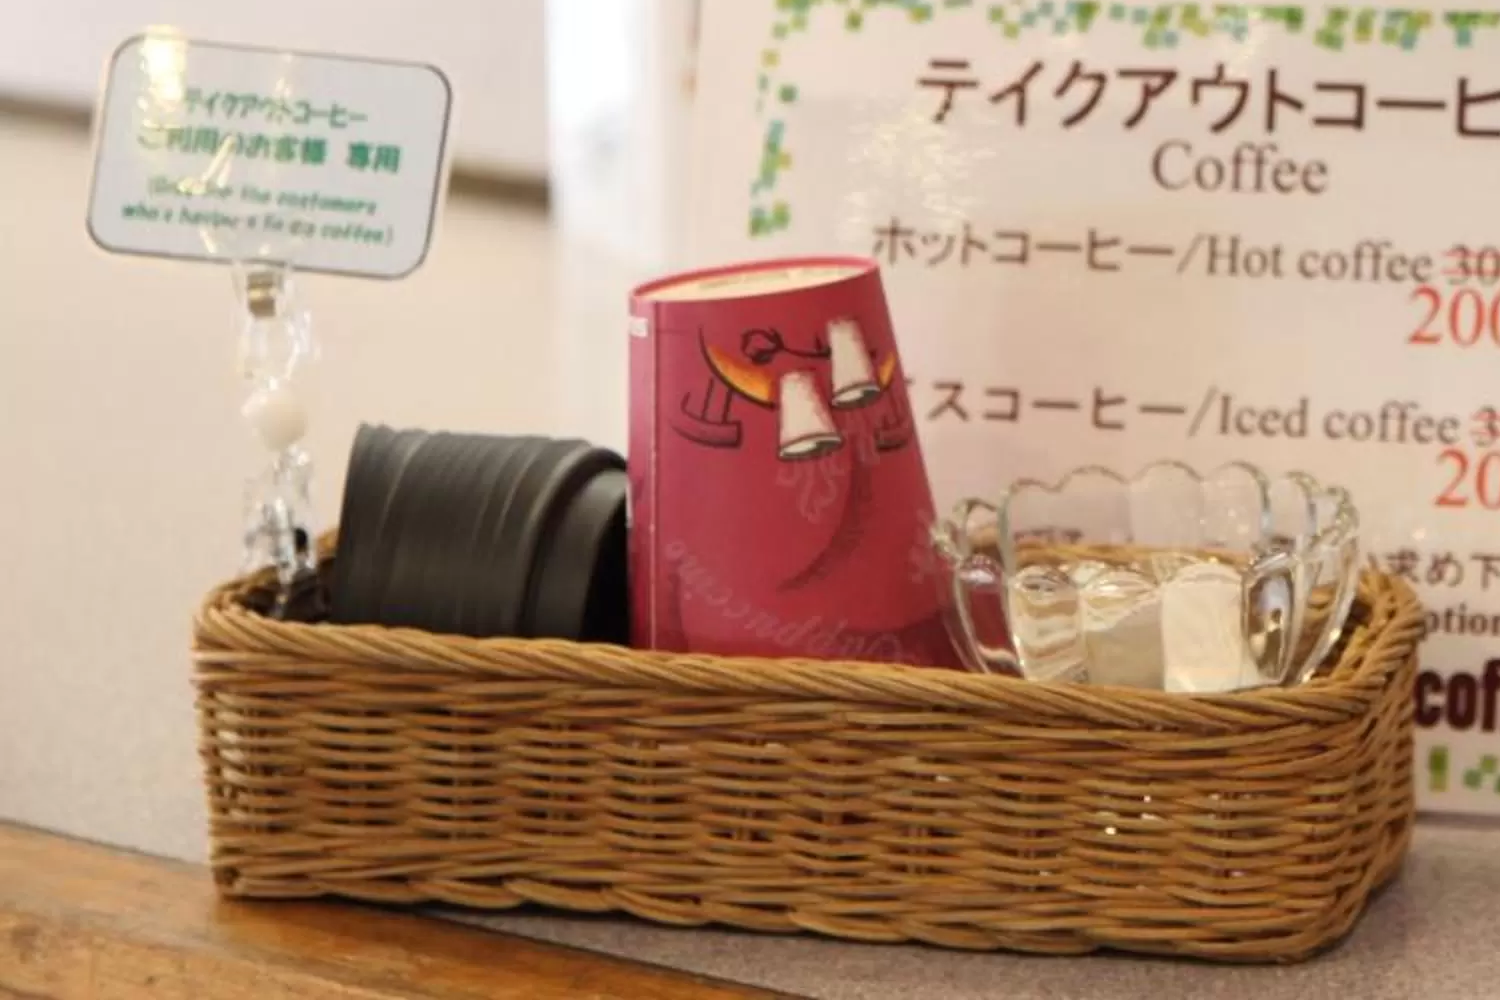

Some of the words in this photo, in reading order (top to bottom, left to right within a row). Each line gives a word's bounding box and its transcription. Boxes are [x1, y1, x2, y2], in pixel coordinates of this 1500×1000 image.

[1151, 139, 1329, 194] Coffee
[1297, 239, 1434, 283] coffee
[904, 376, 1310, 438] スコーヒー/Iced
[1322, 400, 1461, 445] coffee
